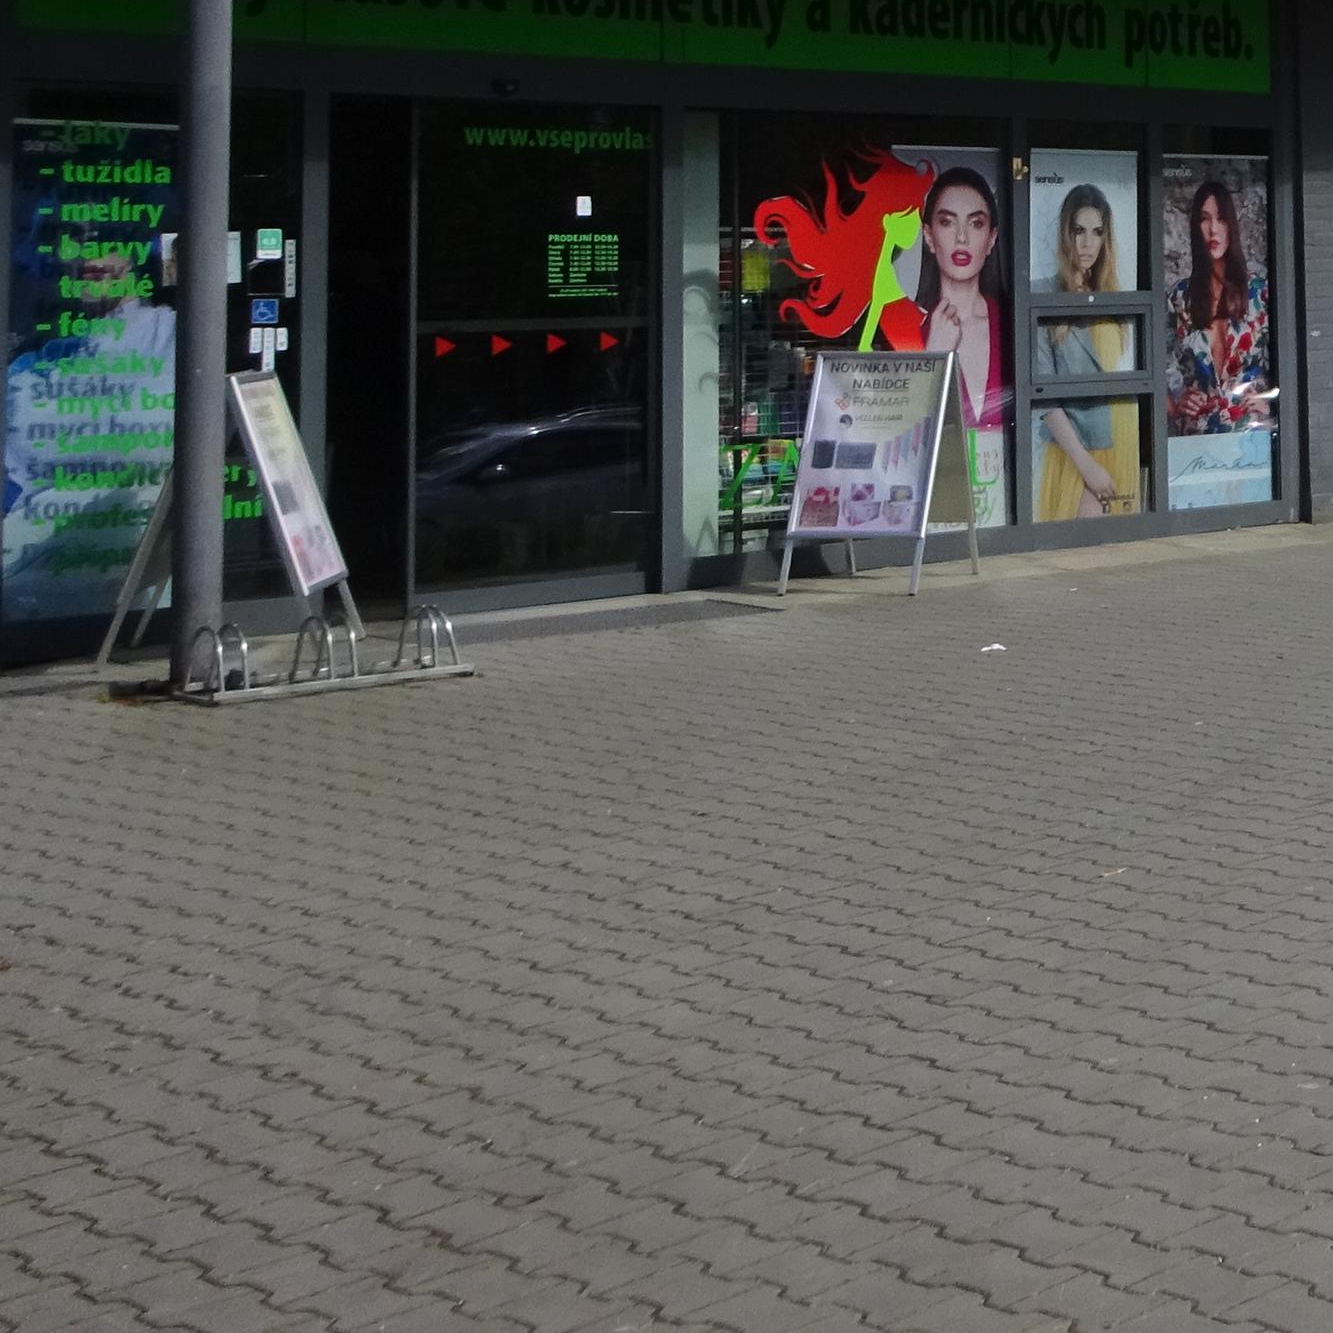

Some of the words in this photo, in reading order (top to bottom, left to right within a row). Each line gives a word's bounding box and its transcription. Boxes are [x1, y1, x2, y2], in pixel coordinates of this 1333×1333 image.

[60, 157, 173, 185] tužidla
[60, 196, 166, 228] melíry
[58, 233, 153, 266] barvy
[548, 233, 592, 242] PRODEJNÍ
[593, 234, 619, 243] DOBA
[58, 271, 155, 299] trvalé
[58, 310, 128, 342] fény
[830, 361, 891, 374] NOVINKA
[893, 361, 901, 373] V
[905, 358, 936, 373] NAŠÍ
[852, 378, 911, 390] NABÍDCE
